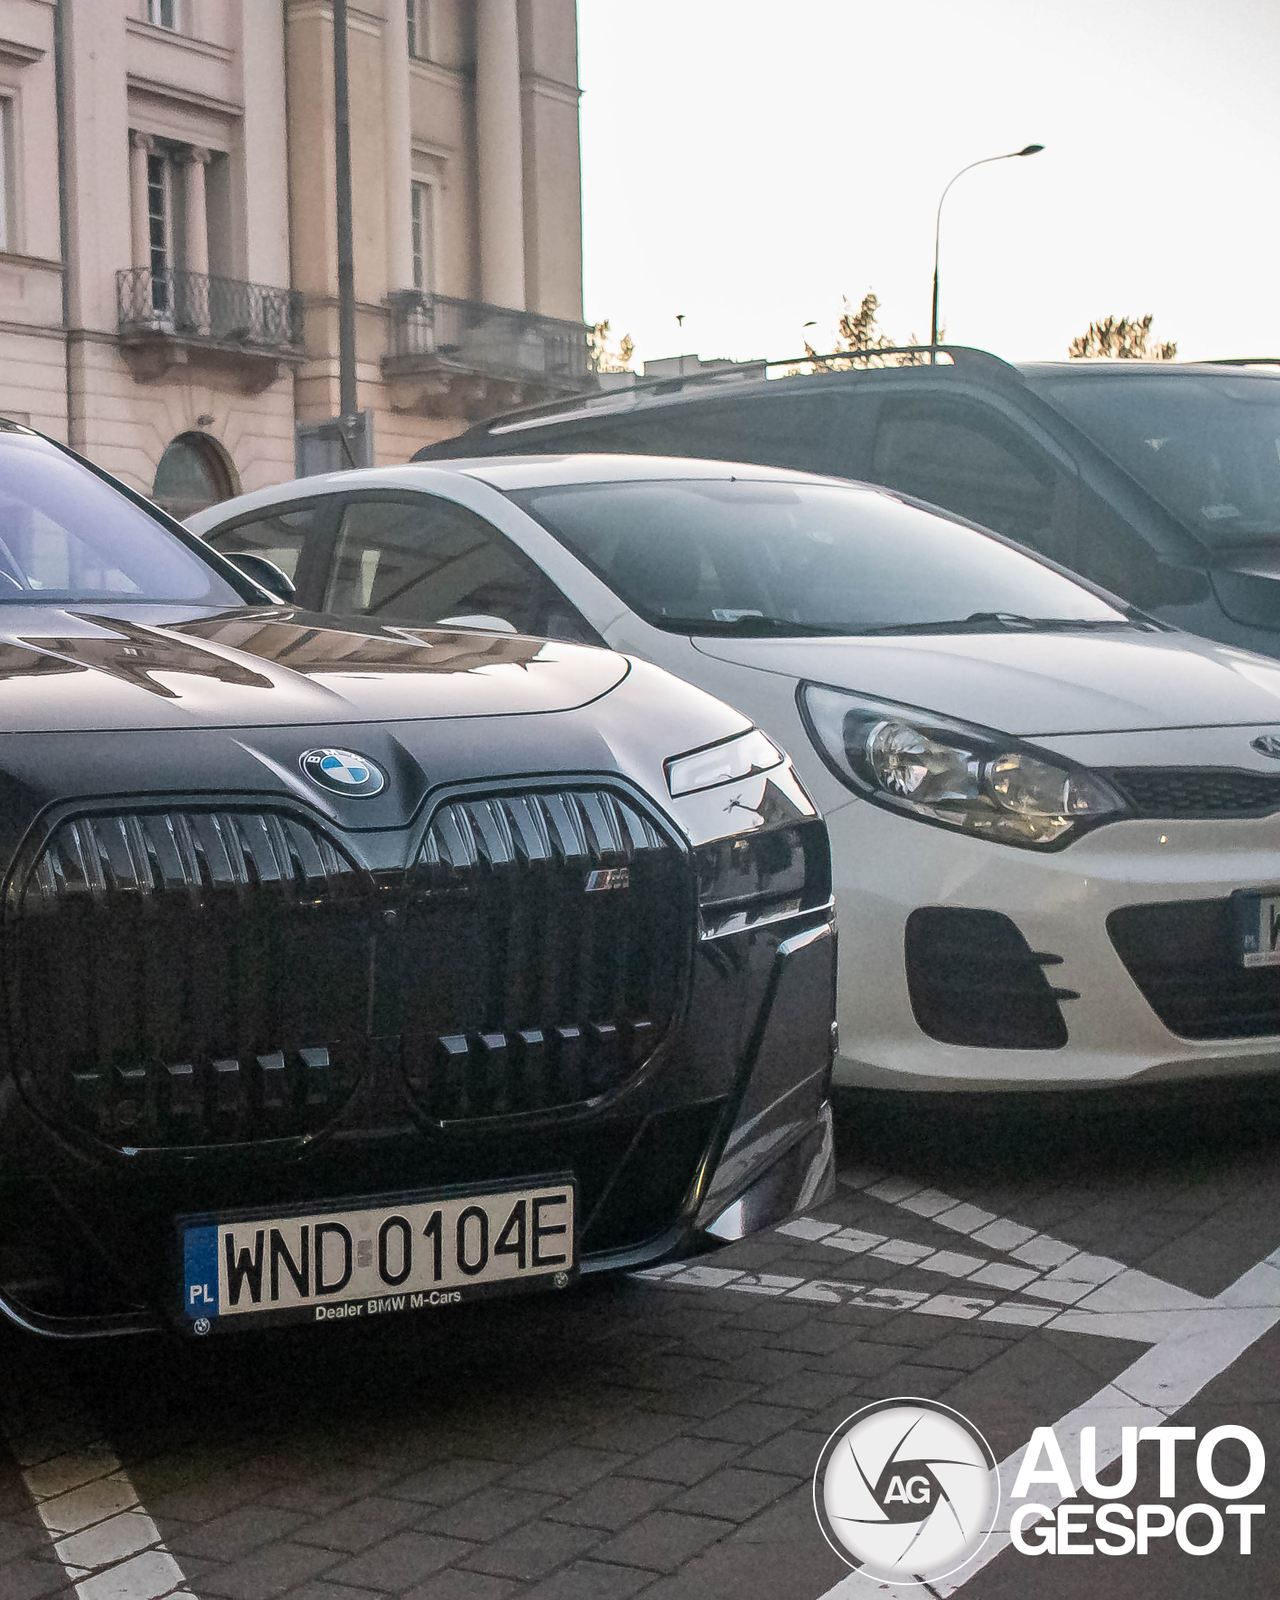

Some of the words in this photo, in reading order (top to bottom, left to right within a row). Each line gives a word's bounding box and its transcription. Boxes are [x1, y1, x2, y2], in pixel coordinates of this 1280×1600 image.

[224, 1221, 353, 1306] WND
[378, 1194, 568, 1287] 0104E
[189, 1284, 214, 1304] PL
[315, 1303, 363, 1321] Dealer
[367, 1296, 405, 1314] BMW
[410, 1289, 462, 1308] M-Cars
